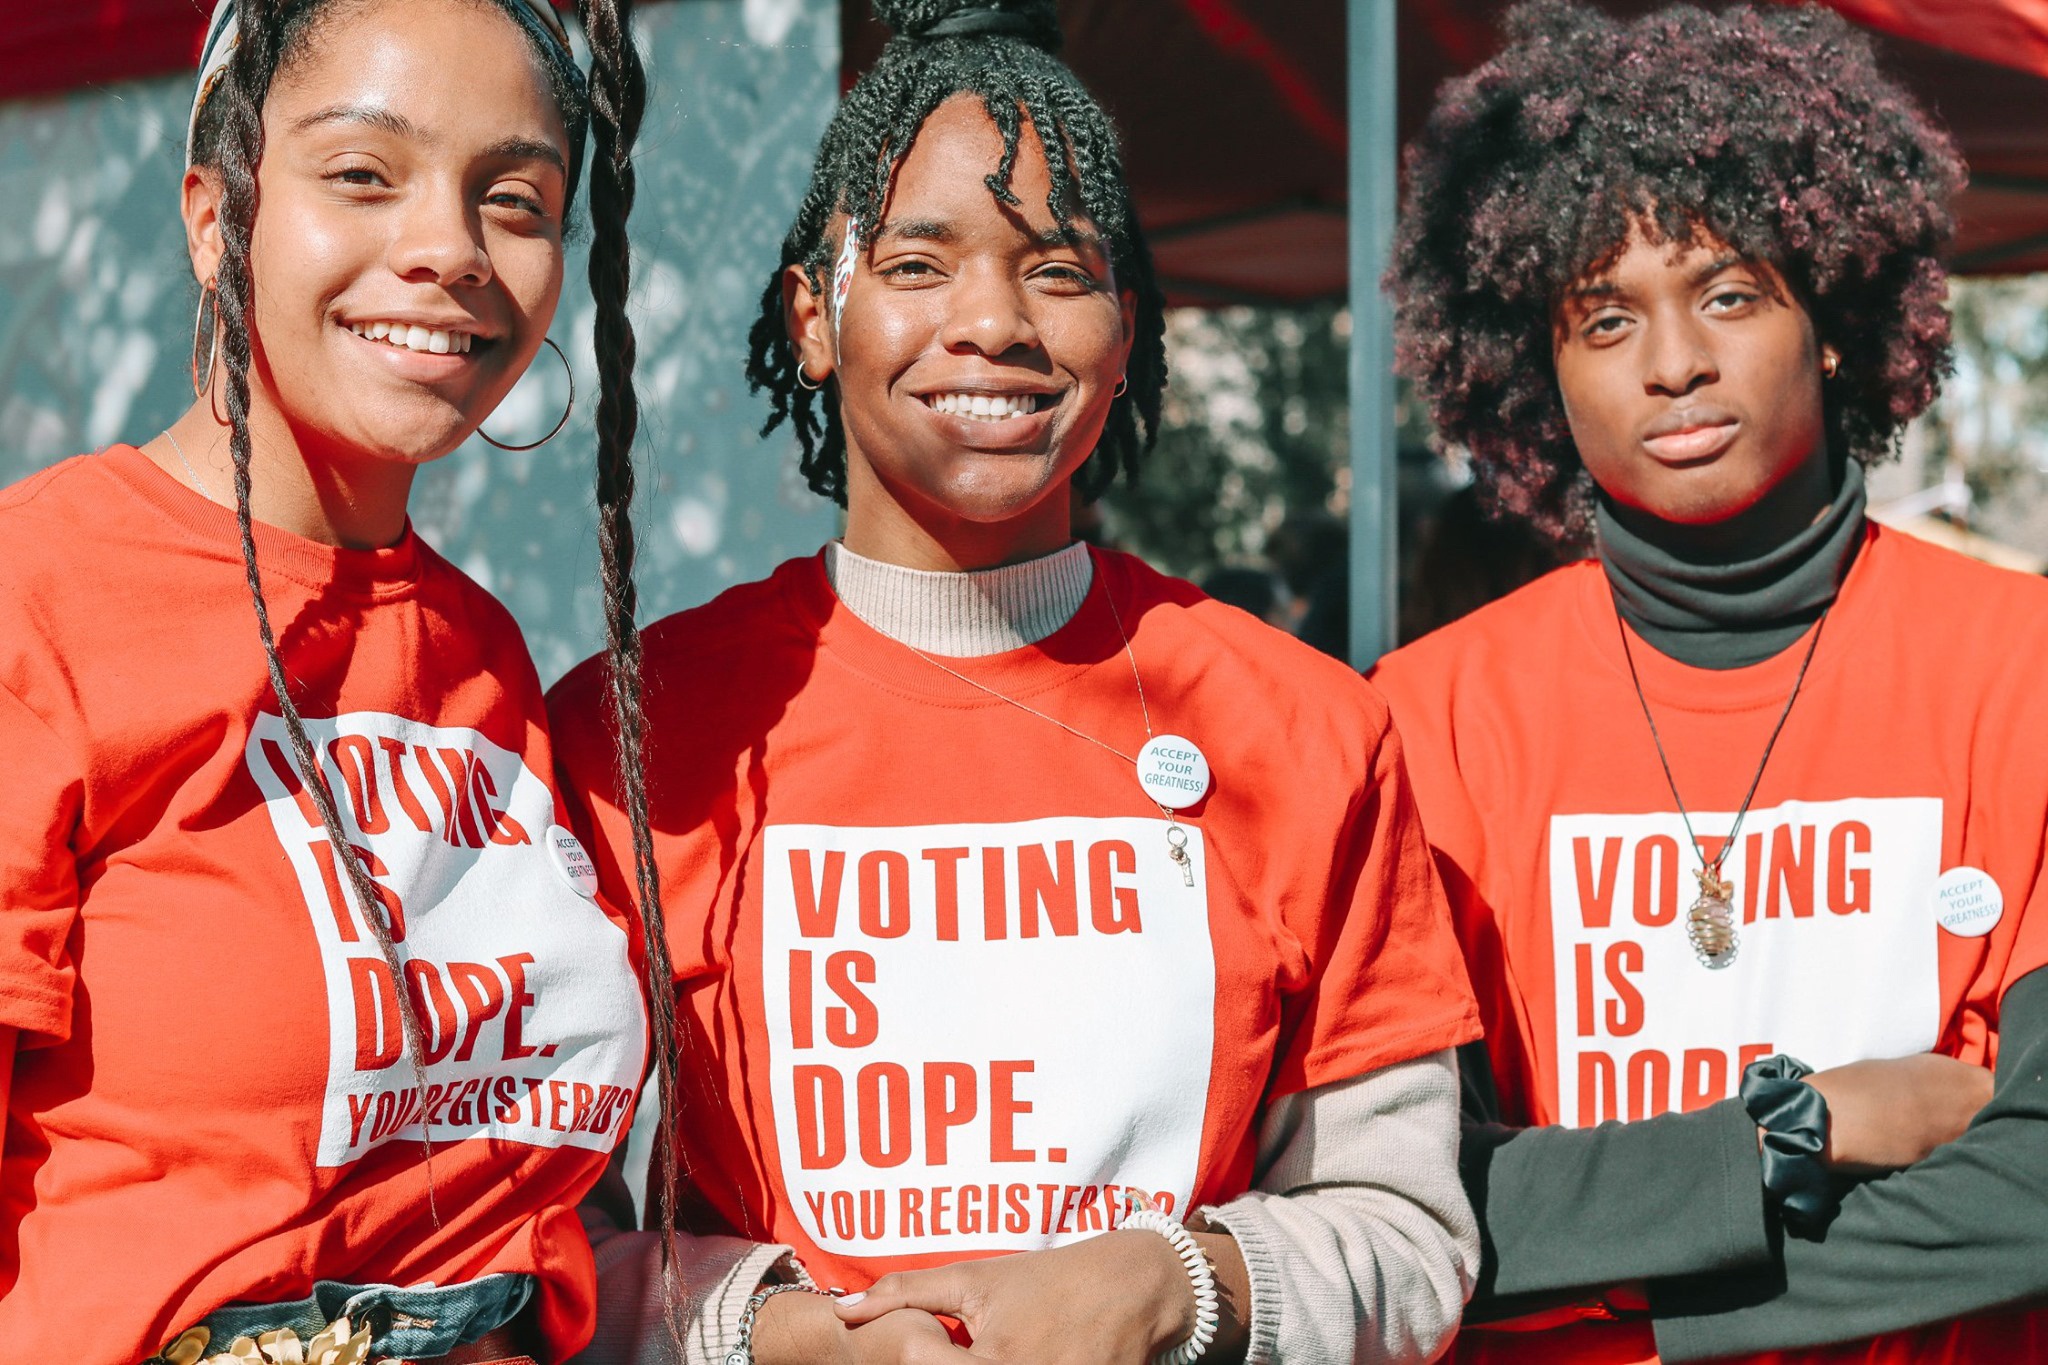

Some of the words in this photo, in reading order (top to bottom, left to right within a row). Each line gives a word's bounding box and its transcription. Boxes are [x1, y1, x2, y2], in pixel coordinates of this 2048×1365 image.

[1144, 772, 1204, 793] GREATNESS!
[1150, 746, 1200, 763] ACCEPT
[1157, 760, 1193, 775] YOUR
[260, 734, 532, 849] VOTING
[556, 838, 580, 848] ACCEPT
[565, 851, 586, 862] YOUR
[308, 839, 406, 943] IS
[788, 839, 1142, 941] VOTING
[1572, 820, 1872, 928] VOTING
[1940, 879, 1983, 898] ACCEPT
[1949, 894, 1983, 910] YOUR
[1943, 903, 1999, 927] GREATNESS!
[346, 952, 559, 1072] DOPE.
[789, 949, 879, 1050] IS
[1574, 941, 1645, 1038] IS
[347, 1087, 418, 1148] YOU
[792, 1059, 1067, 1170] DOPE.
[803, 1189, 885, 1240] YOU
